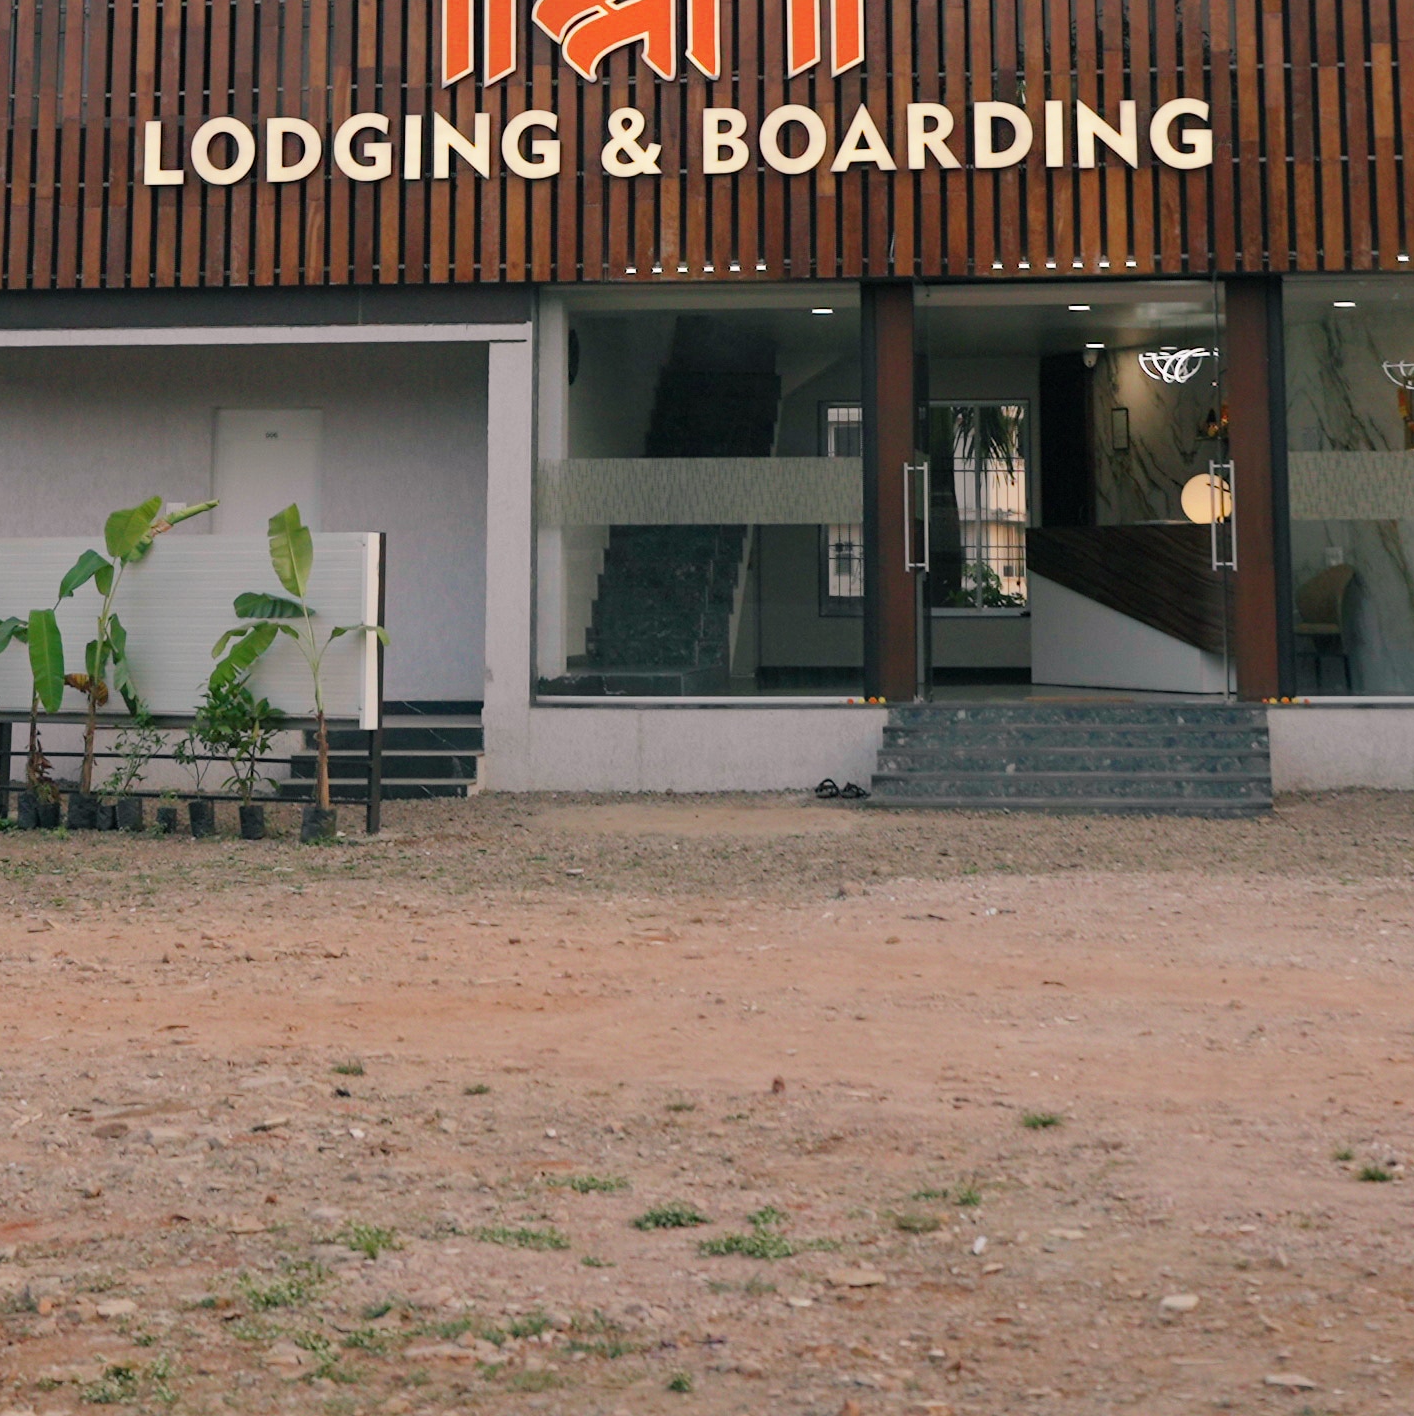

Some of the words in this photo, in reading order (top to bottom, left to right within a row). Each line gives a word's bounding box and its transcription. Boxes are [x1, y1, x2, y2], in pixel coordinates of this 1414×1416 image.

[144, 111, 560, 185] LODGING
[602, 108, 661, 177] &
[703, 98, 1212, 174] BOARDING
